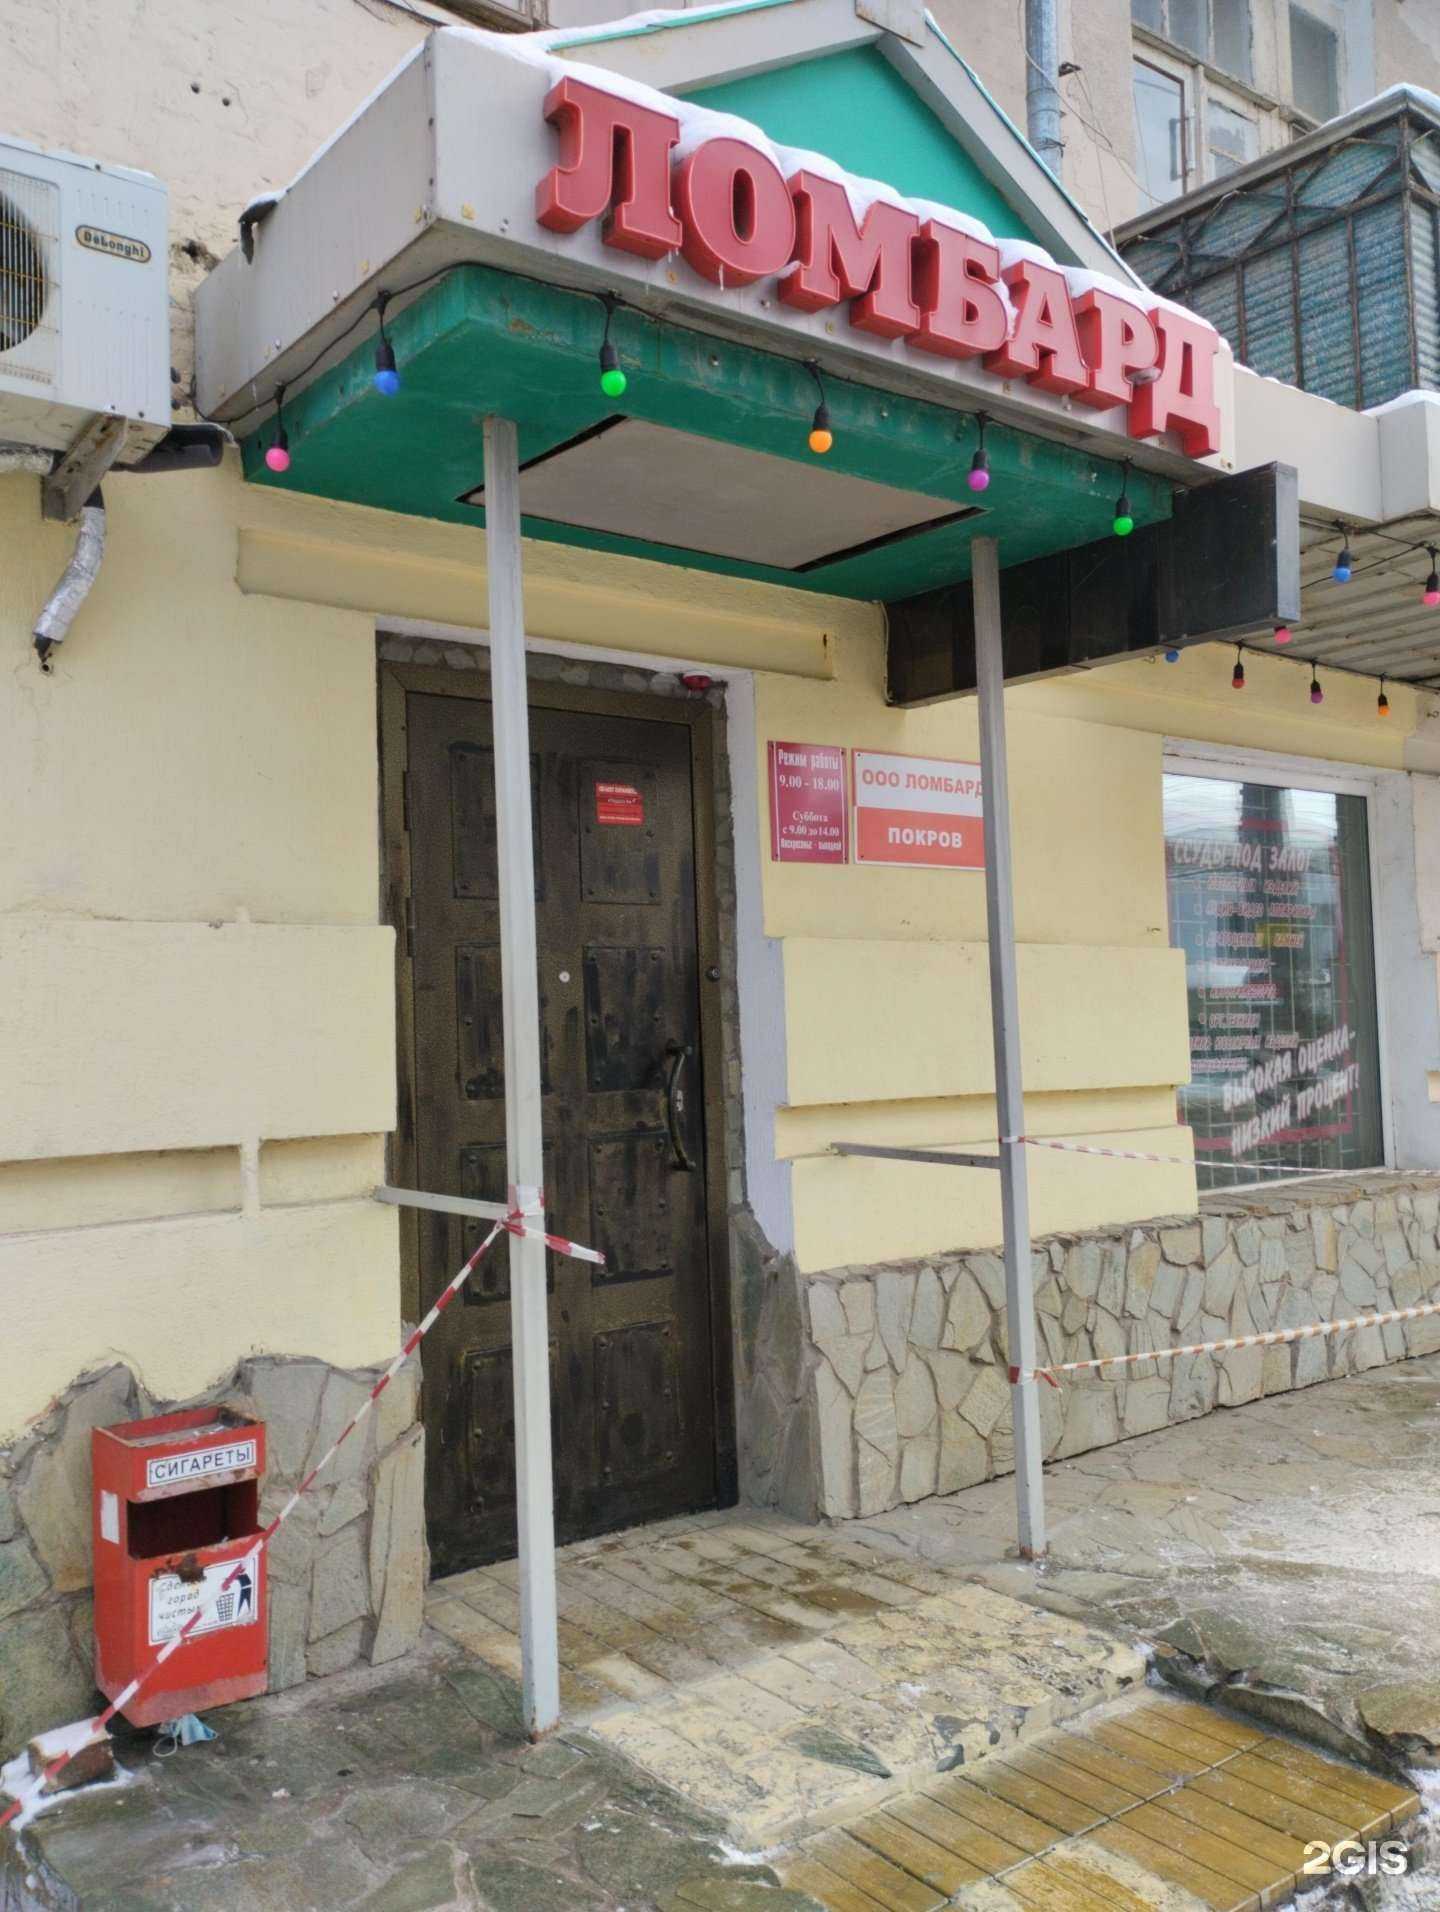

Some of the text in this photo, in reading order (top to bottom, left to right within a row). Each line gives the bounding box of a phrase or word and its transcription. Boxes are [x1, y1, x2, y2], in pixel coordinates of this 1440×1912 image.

[83, 231, 145, 257] DeLonghi
[536, 76, 1220, 458] ЛОМБАРД
[778, 748, 839, 772] Режим работы
[862, 769, 900, 788] ООО
[792, 810, 829, 823] Суббота
[888, 827, 963, 848] ПОКРОВ
[1231, 843, 1262, 873] ПОД
[1231, 1093, 1292, 1156] НИЗКИЙ
[154, 1446, 250, 1480] СИГАРЕТЫ
